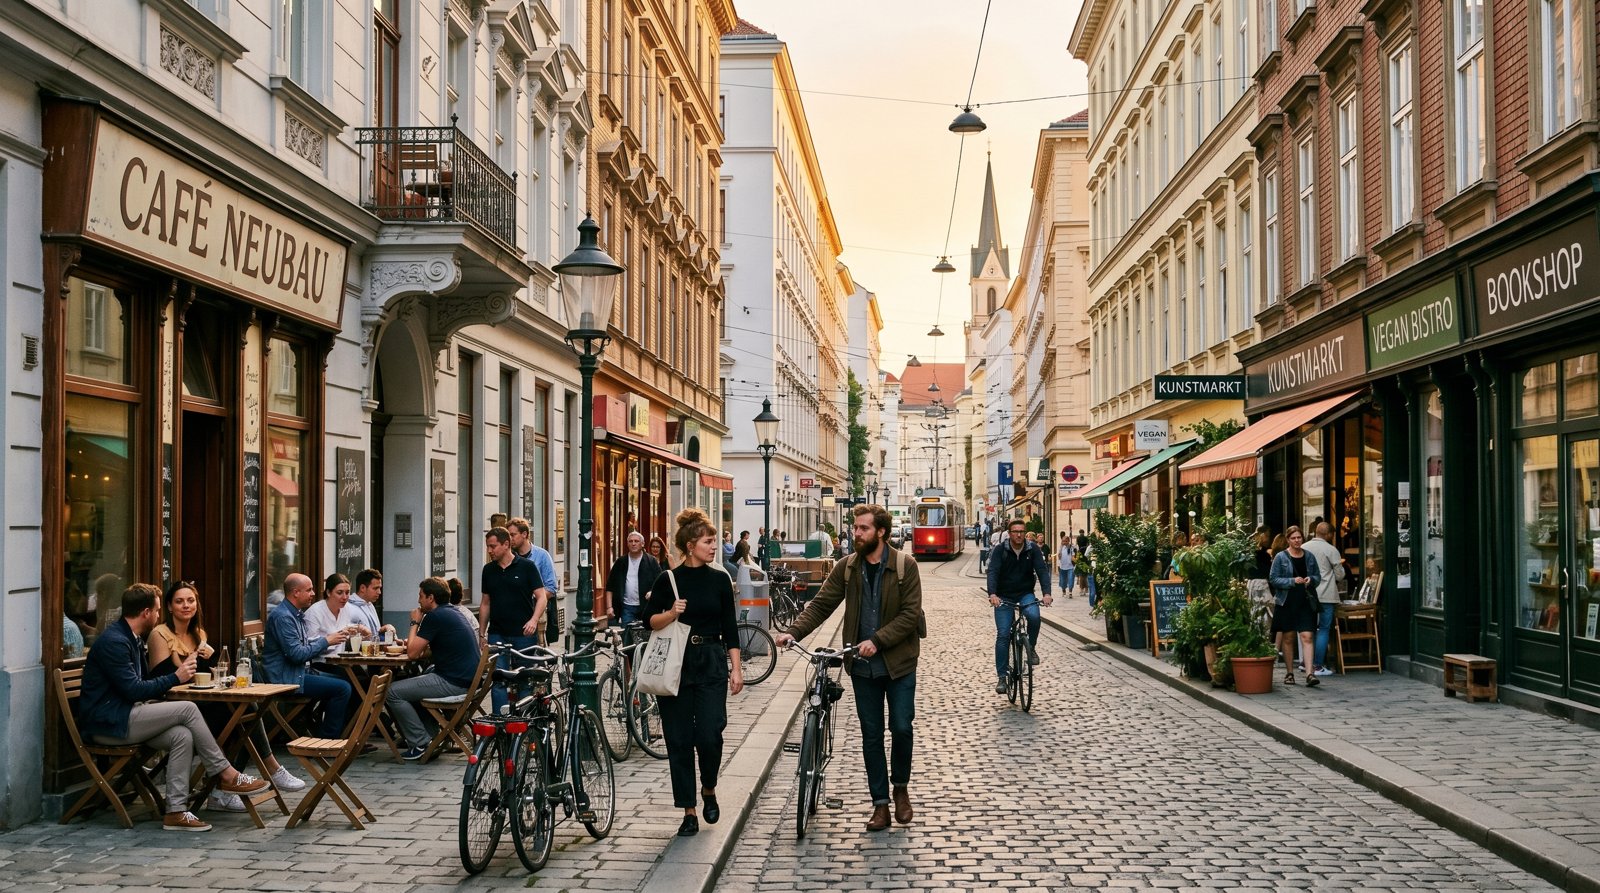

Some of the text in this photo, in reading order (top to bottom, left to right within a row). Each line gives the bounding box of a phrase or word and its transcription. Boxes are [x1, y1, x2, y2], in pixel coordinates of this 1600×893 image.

[120, 156, 330, 304] CAFÉ NEUBAU
[1486, 242, 1583, 315] BOOKSHOP
[1372, 296, 1454, 354] VEGAN BISTRO
[1158, 381, 1242, 393] KUNSTMARKT
[1267, 335, 1345, 394] KUNSTMARKT
